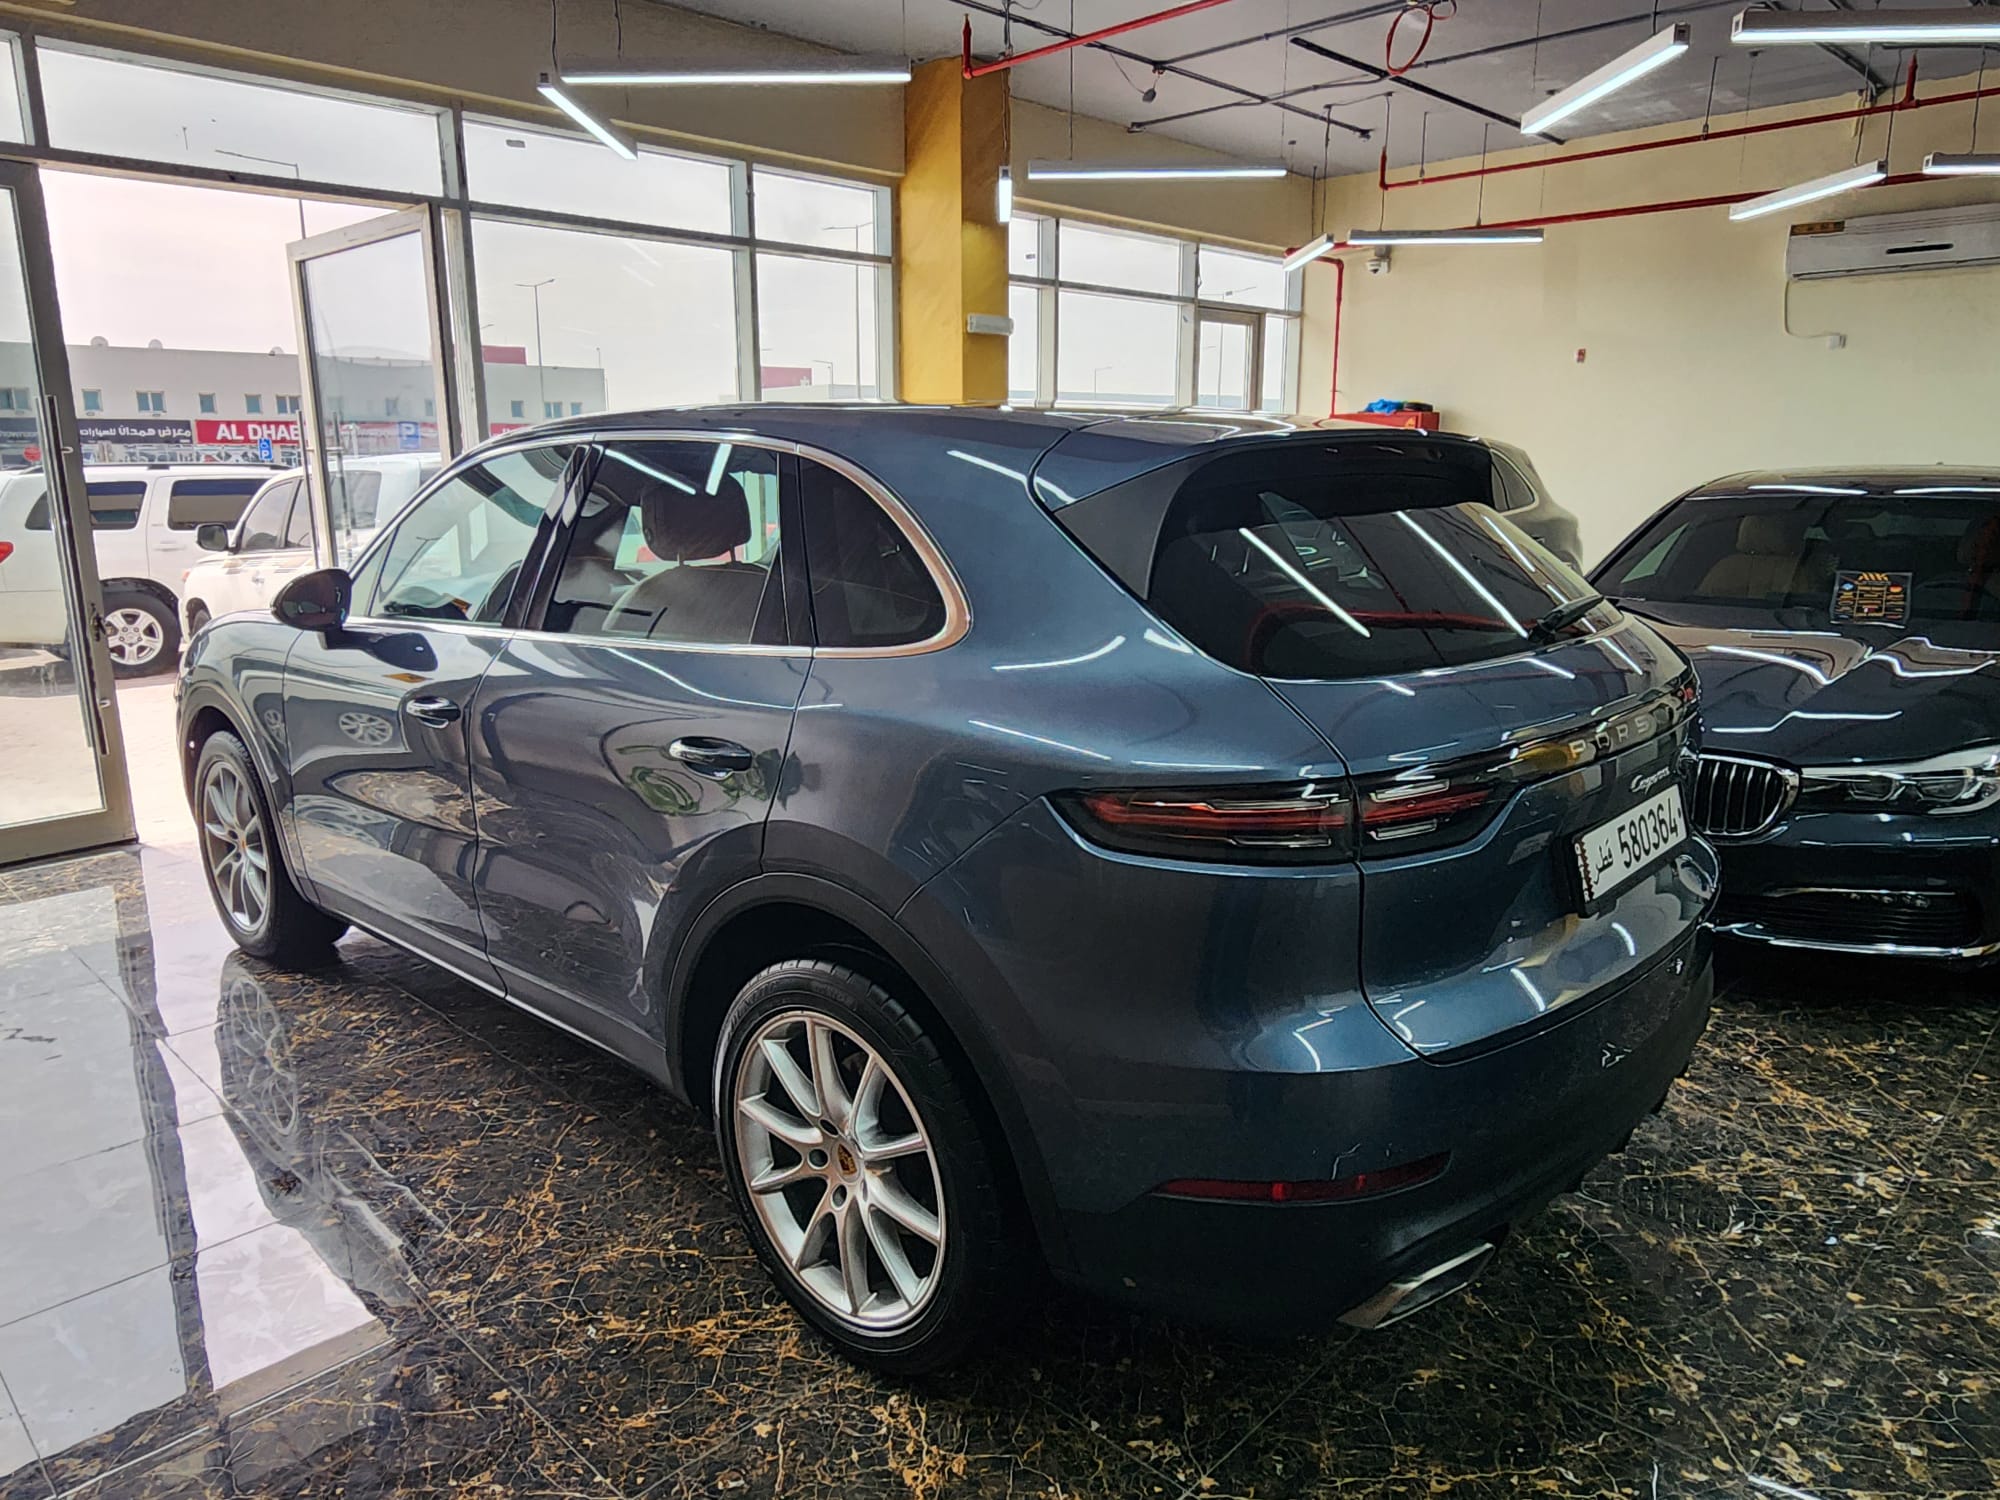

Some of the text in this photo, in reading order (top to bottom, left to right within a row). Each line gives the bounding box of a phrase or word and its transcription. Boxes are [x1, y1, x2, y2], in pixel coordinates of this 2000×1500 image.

[216, 423, 244, 440] AL
[401, 423, 415, 440] P
[261, 449, 270, 460] P
[1617, 798, 1678, 869] 580364
